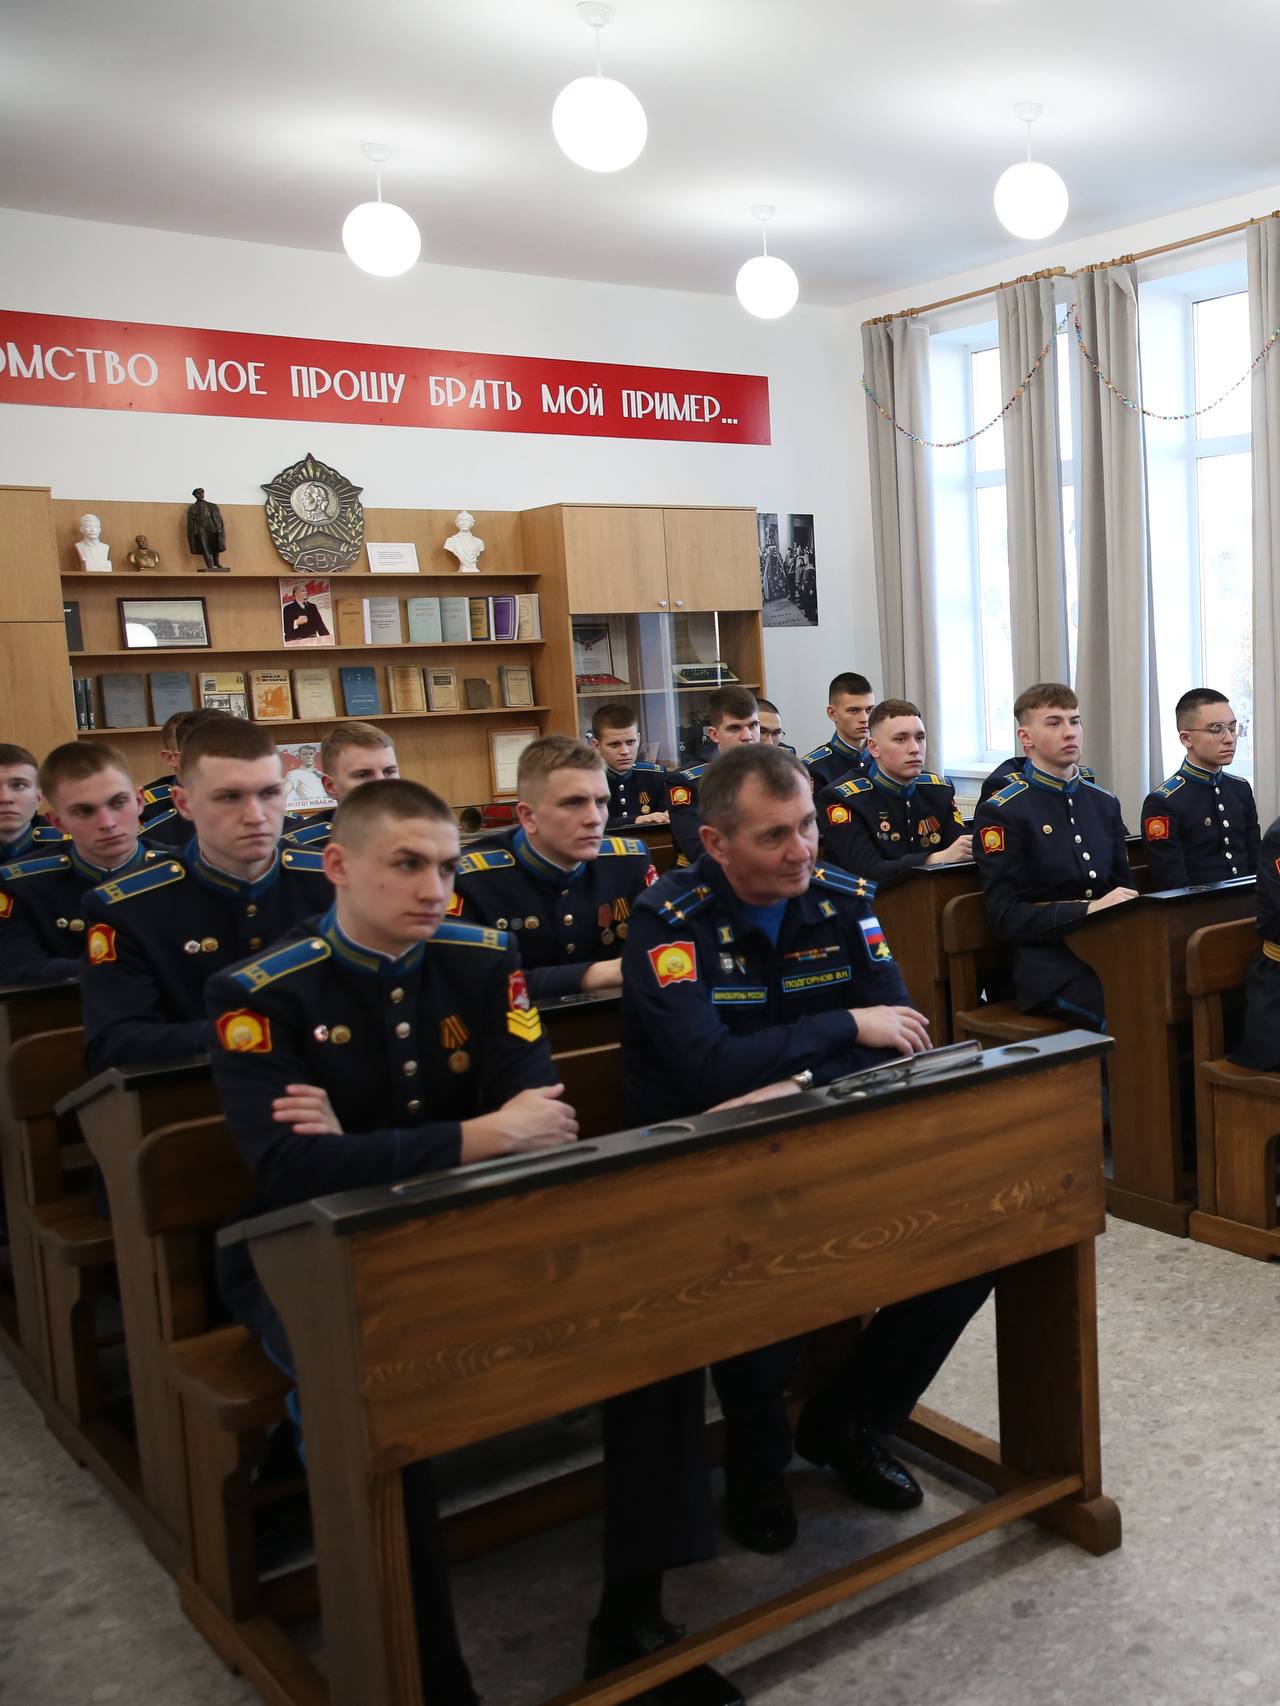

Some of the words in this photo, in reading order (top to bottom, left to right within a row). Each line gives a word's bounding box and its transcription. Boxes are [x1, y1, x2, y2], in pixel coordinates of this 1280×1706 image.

[0, 342, 158, 387] МСТВО
[185, 357, 267, 395] МОЕ
[290, 365, 405, 403] ПРОШУ
[429, 376, 522, 411] БРАТЬ
[541, 383, 604, 416] МОЙ
[622, 389, 738, 425] ПРИМЕР...
